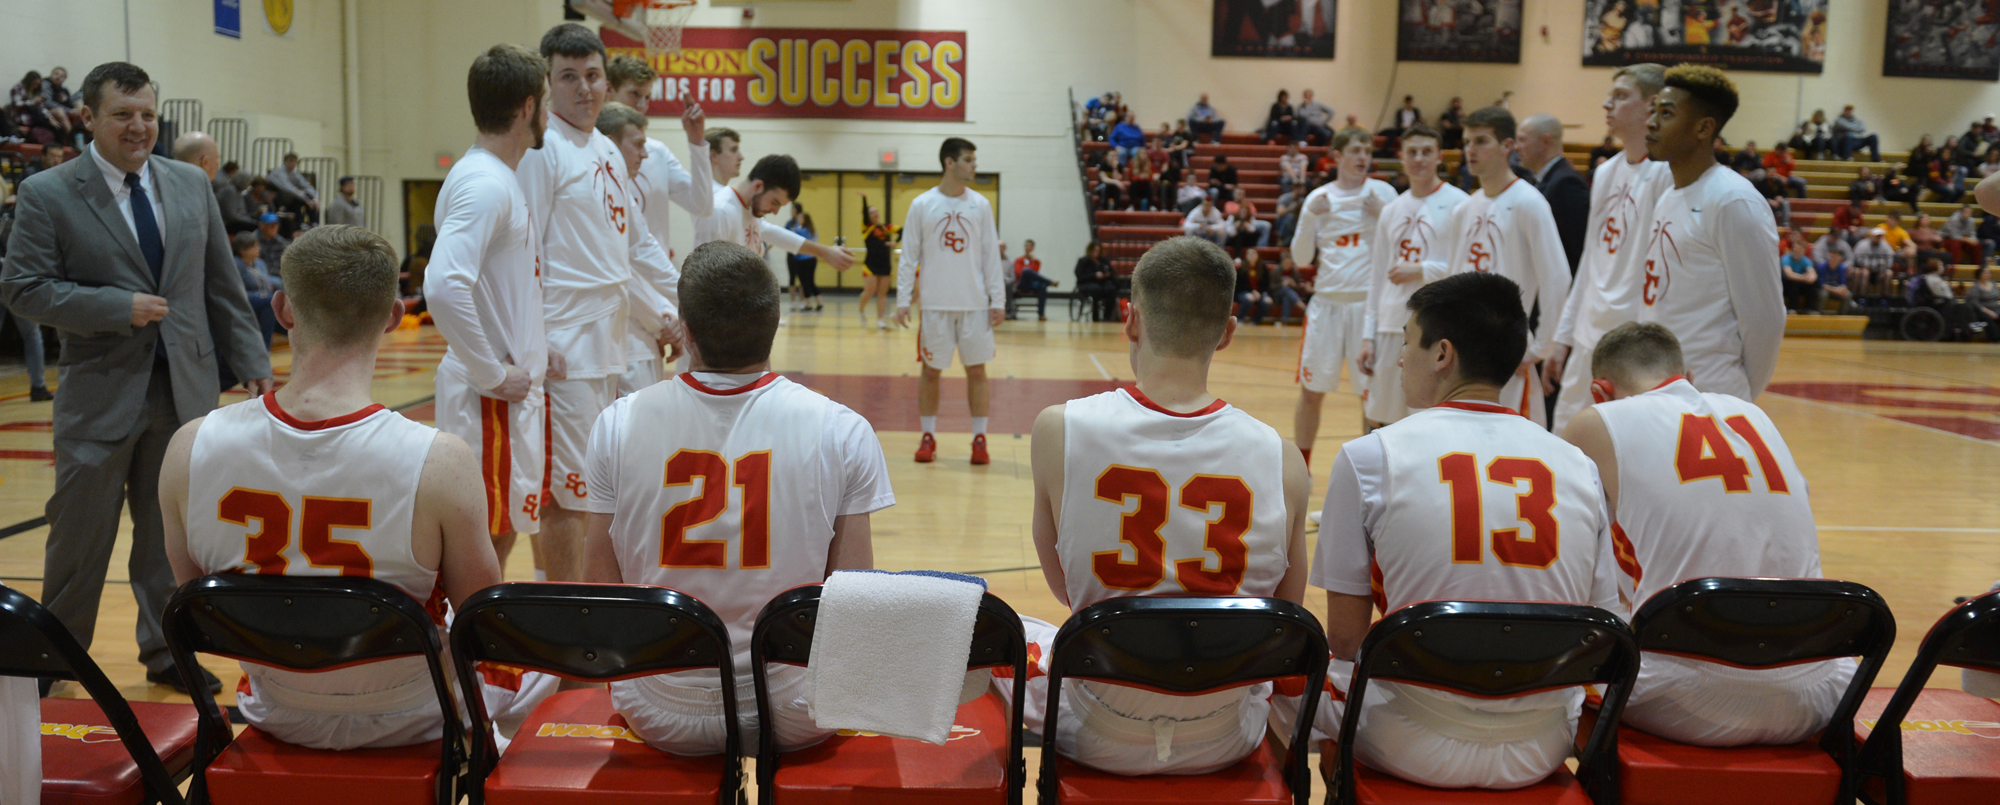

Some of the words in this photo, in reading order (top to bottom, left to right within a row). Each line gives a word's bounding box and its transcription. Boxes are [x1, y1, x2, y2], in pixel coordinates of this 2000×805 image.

[698, 77, 736, 102] FOR
[747, 37, 962, 109] SUCCESS
[944, 231, 964, 253] SC
[1400, 239, 1421, 263] SC
[1468, 242, 1490, 272] SC
[1603, 217, 1620, 254] SC
[1643, 259, 1660, 306] SC
[1673, 412, 1791, 495] 41
[565, 472, 587, 498] SC
[658, 448, 772, 569] 21
[217, 486, 374, 578] 35
[1091, 463, 1254, 595] 33
[1437, 451, 1559, 570] 13
